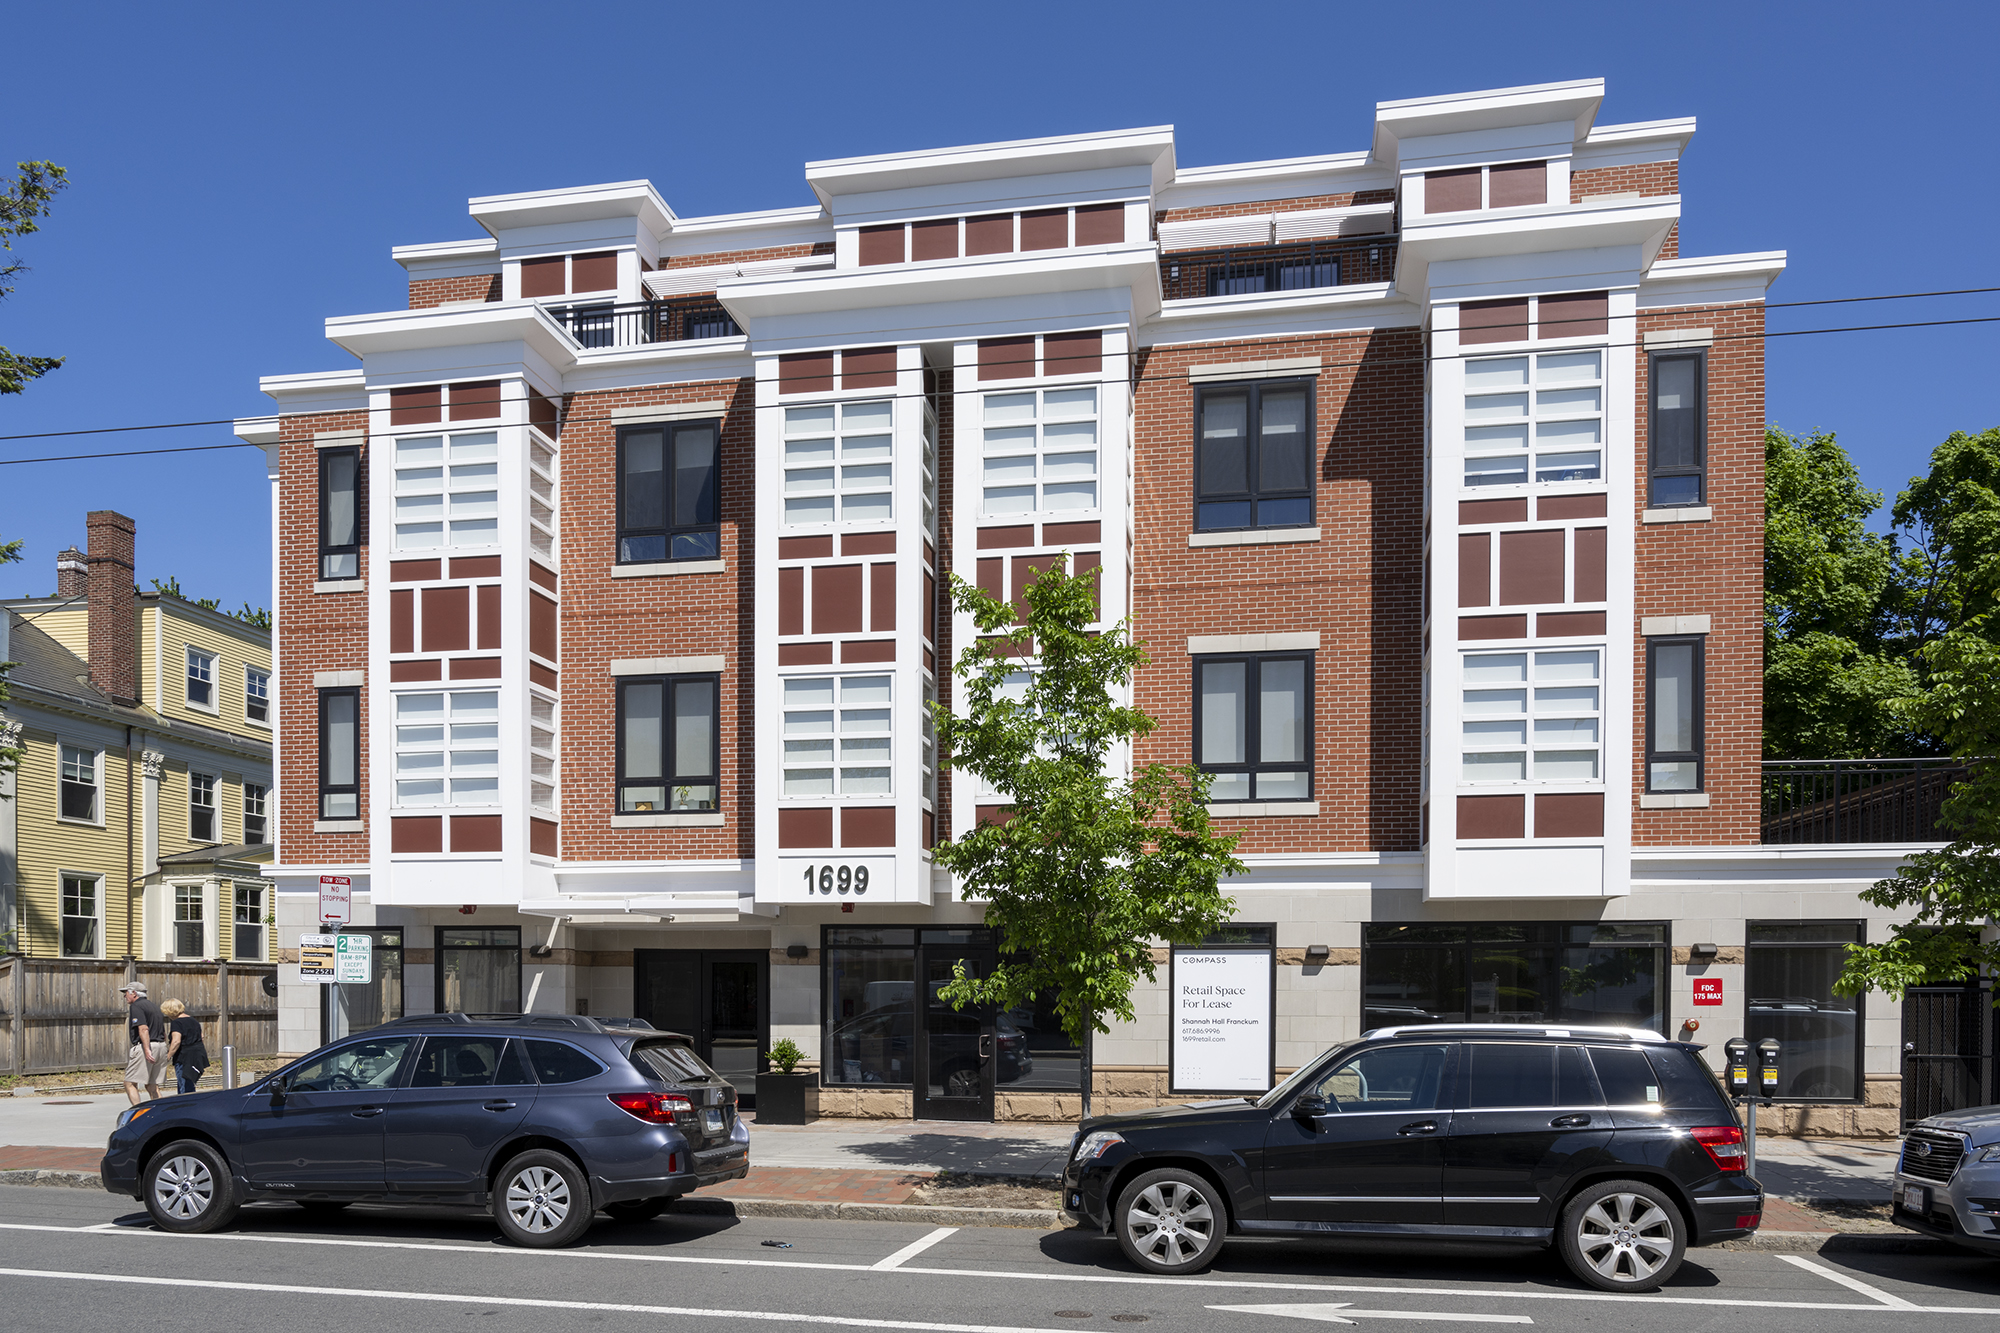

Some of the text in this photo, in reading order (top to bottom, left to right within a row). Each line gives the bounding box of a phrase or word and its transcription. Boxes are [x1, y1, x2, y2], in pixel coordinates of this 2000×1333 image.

[803, 865, 869, 895] 1699
[339, 938, 346, 950] 2
[1182, 956, 1227, 964] COMPASS
[1182, 985, 1246, 997] Retail Space
[1182, 999, 1232, 1009] For Lease
